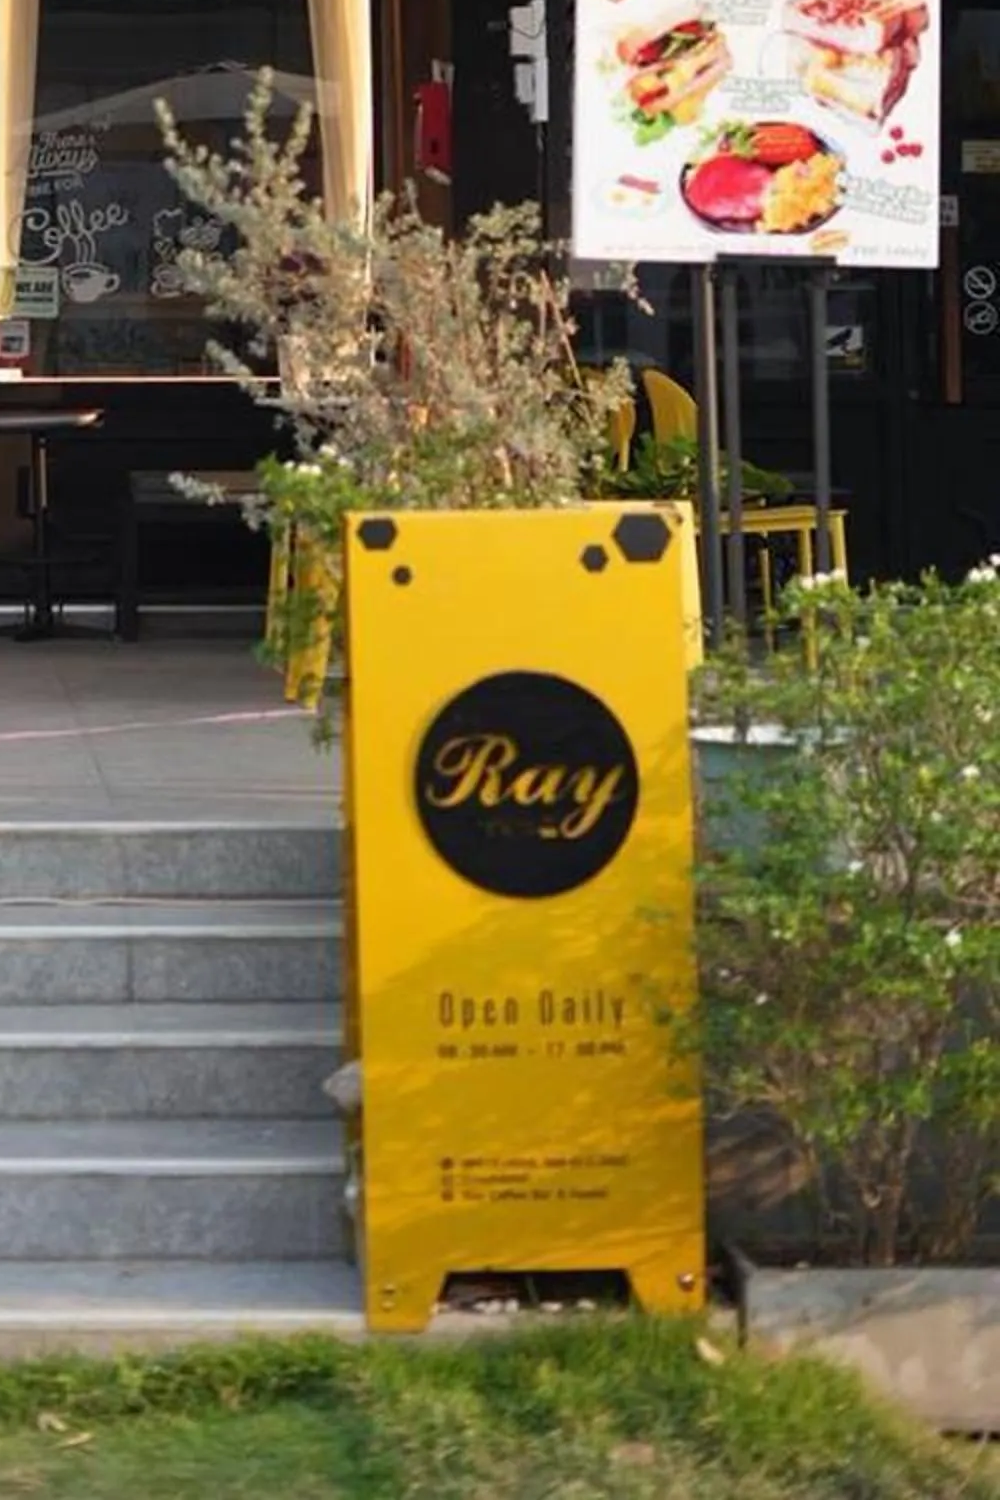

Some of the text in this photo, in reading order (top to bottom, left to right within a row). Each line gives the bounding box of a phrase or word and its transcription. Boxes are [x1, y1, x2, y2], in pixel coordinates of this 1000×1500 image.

[427, 734, 624, 839] Ray
[438, 988, 626, 1032] Open Daily
